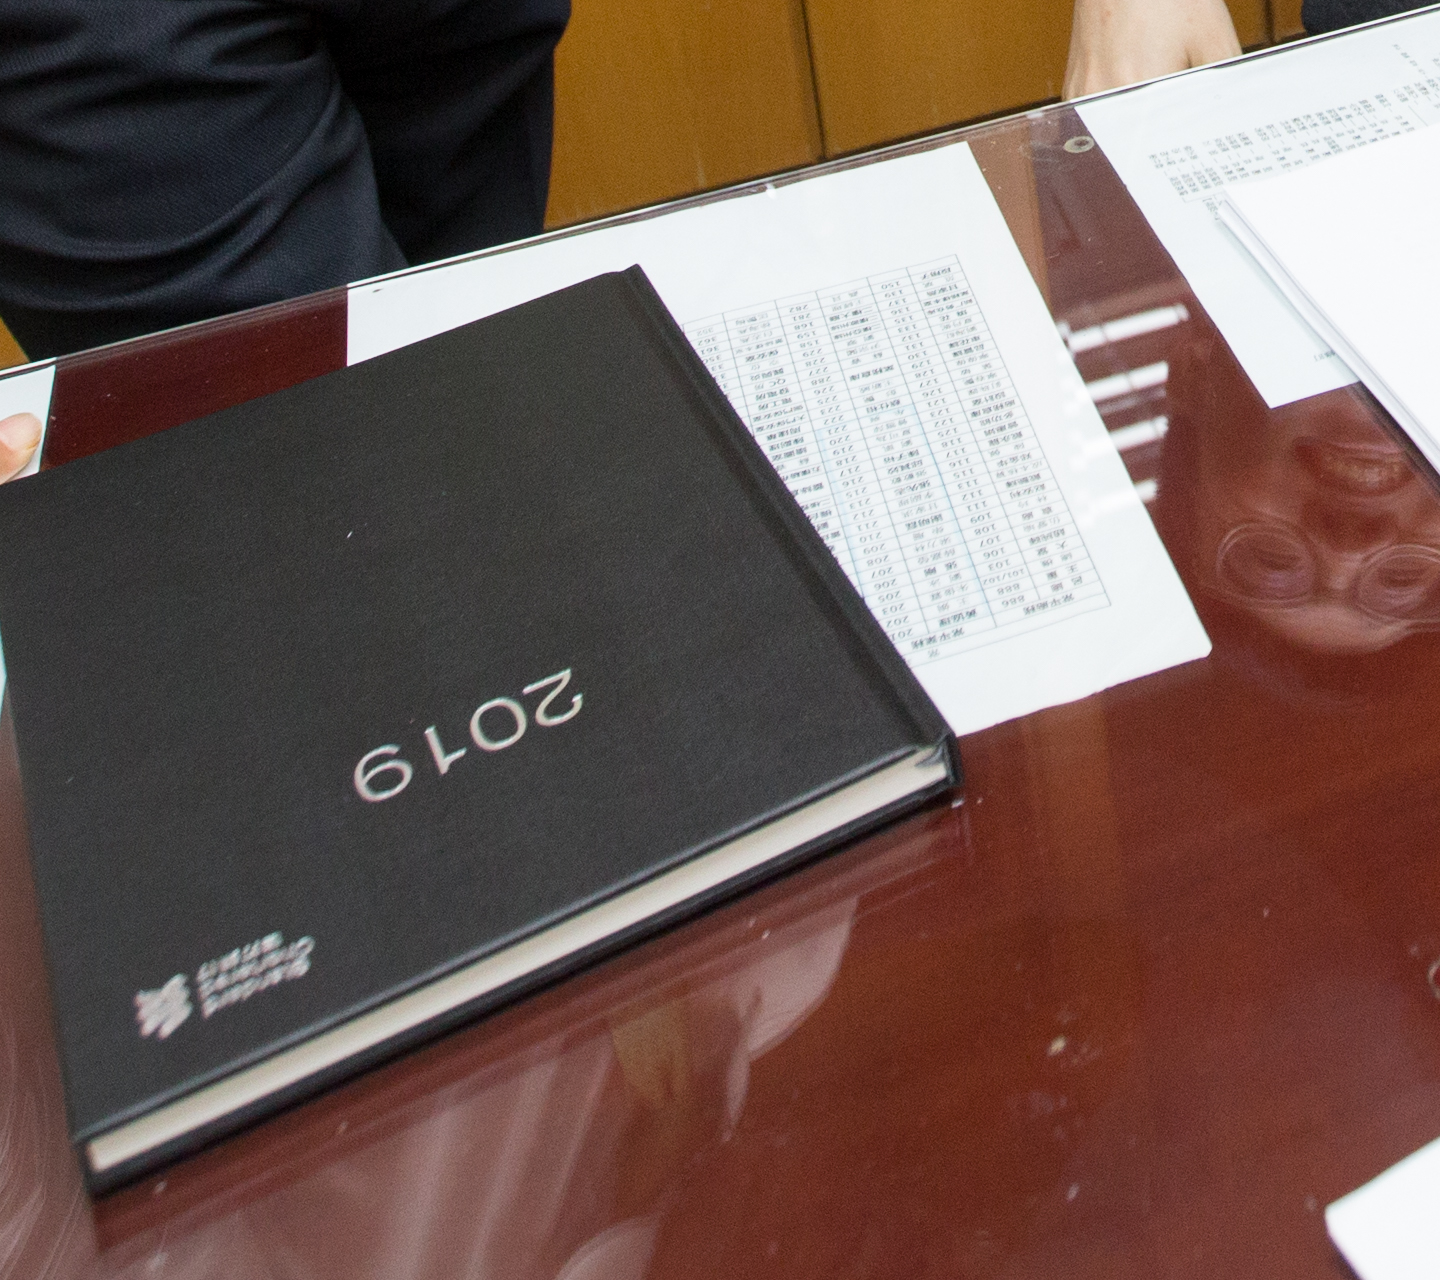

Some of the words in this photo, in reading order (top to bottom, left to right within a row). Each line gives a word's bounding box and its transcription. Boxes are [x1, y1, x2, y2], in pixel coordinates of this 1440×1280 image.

[934, 416, 954, 428] 122
[937, 426, 958, 438] 125
[828, 434, 850, 446] 220
[940, 436, 962, 449] 118
[945, 446, 966, 459] 117
[835, 454, 857, 467] 218
[839, 464, 861, 478] 217
[952, 467, 975, 479] 115
[841, 475, 864, 488] 216
[845, 486, 868, 499] 215
[961, 488, 983, 502] 112
[848, 497, 871, 510] 213
[966, 499, 988, 513] 111
[969, 511, 992, 524] 109
[856, 519, 878, 532] 211
[973, 523, 996, 536] 108
[858, 531, 882, 544] 210
[979, 534, 1001, 548] 107
[982, 546, 1005, 560] 106
[866, 554, 889, 567] 208
[987, 558, 1010, 572] 103
[871, 566, 893, 579] 207
[979, 568, 1024, 587] 101/102
[874, 578, 897, 590] 206
[996, 583, 1020, 595] 888
[877, 590, 901, 603] 205
[1001, 594, 1025, 607] 886
[881, 602, 905, 616] 203
[886, 615, 909, 628] 202
[349, 665, 587, 806] 2019
